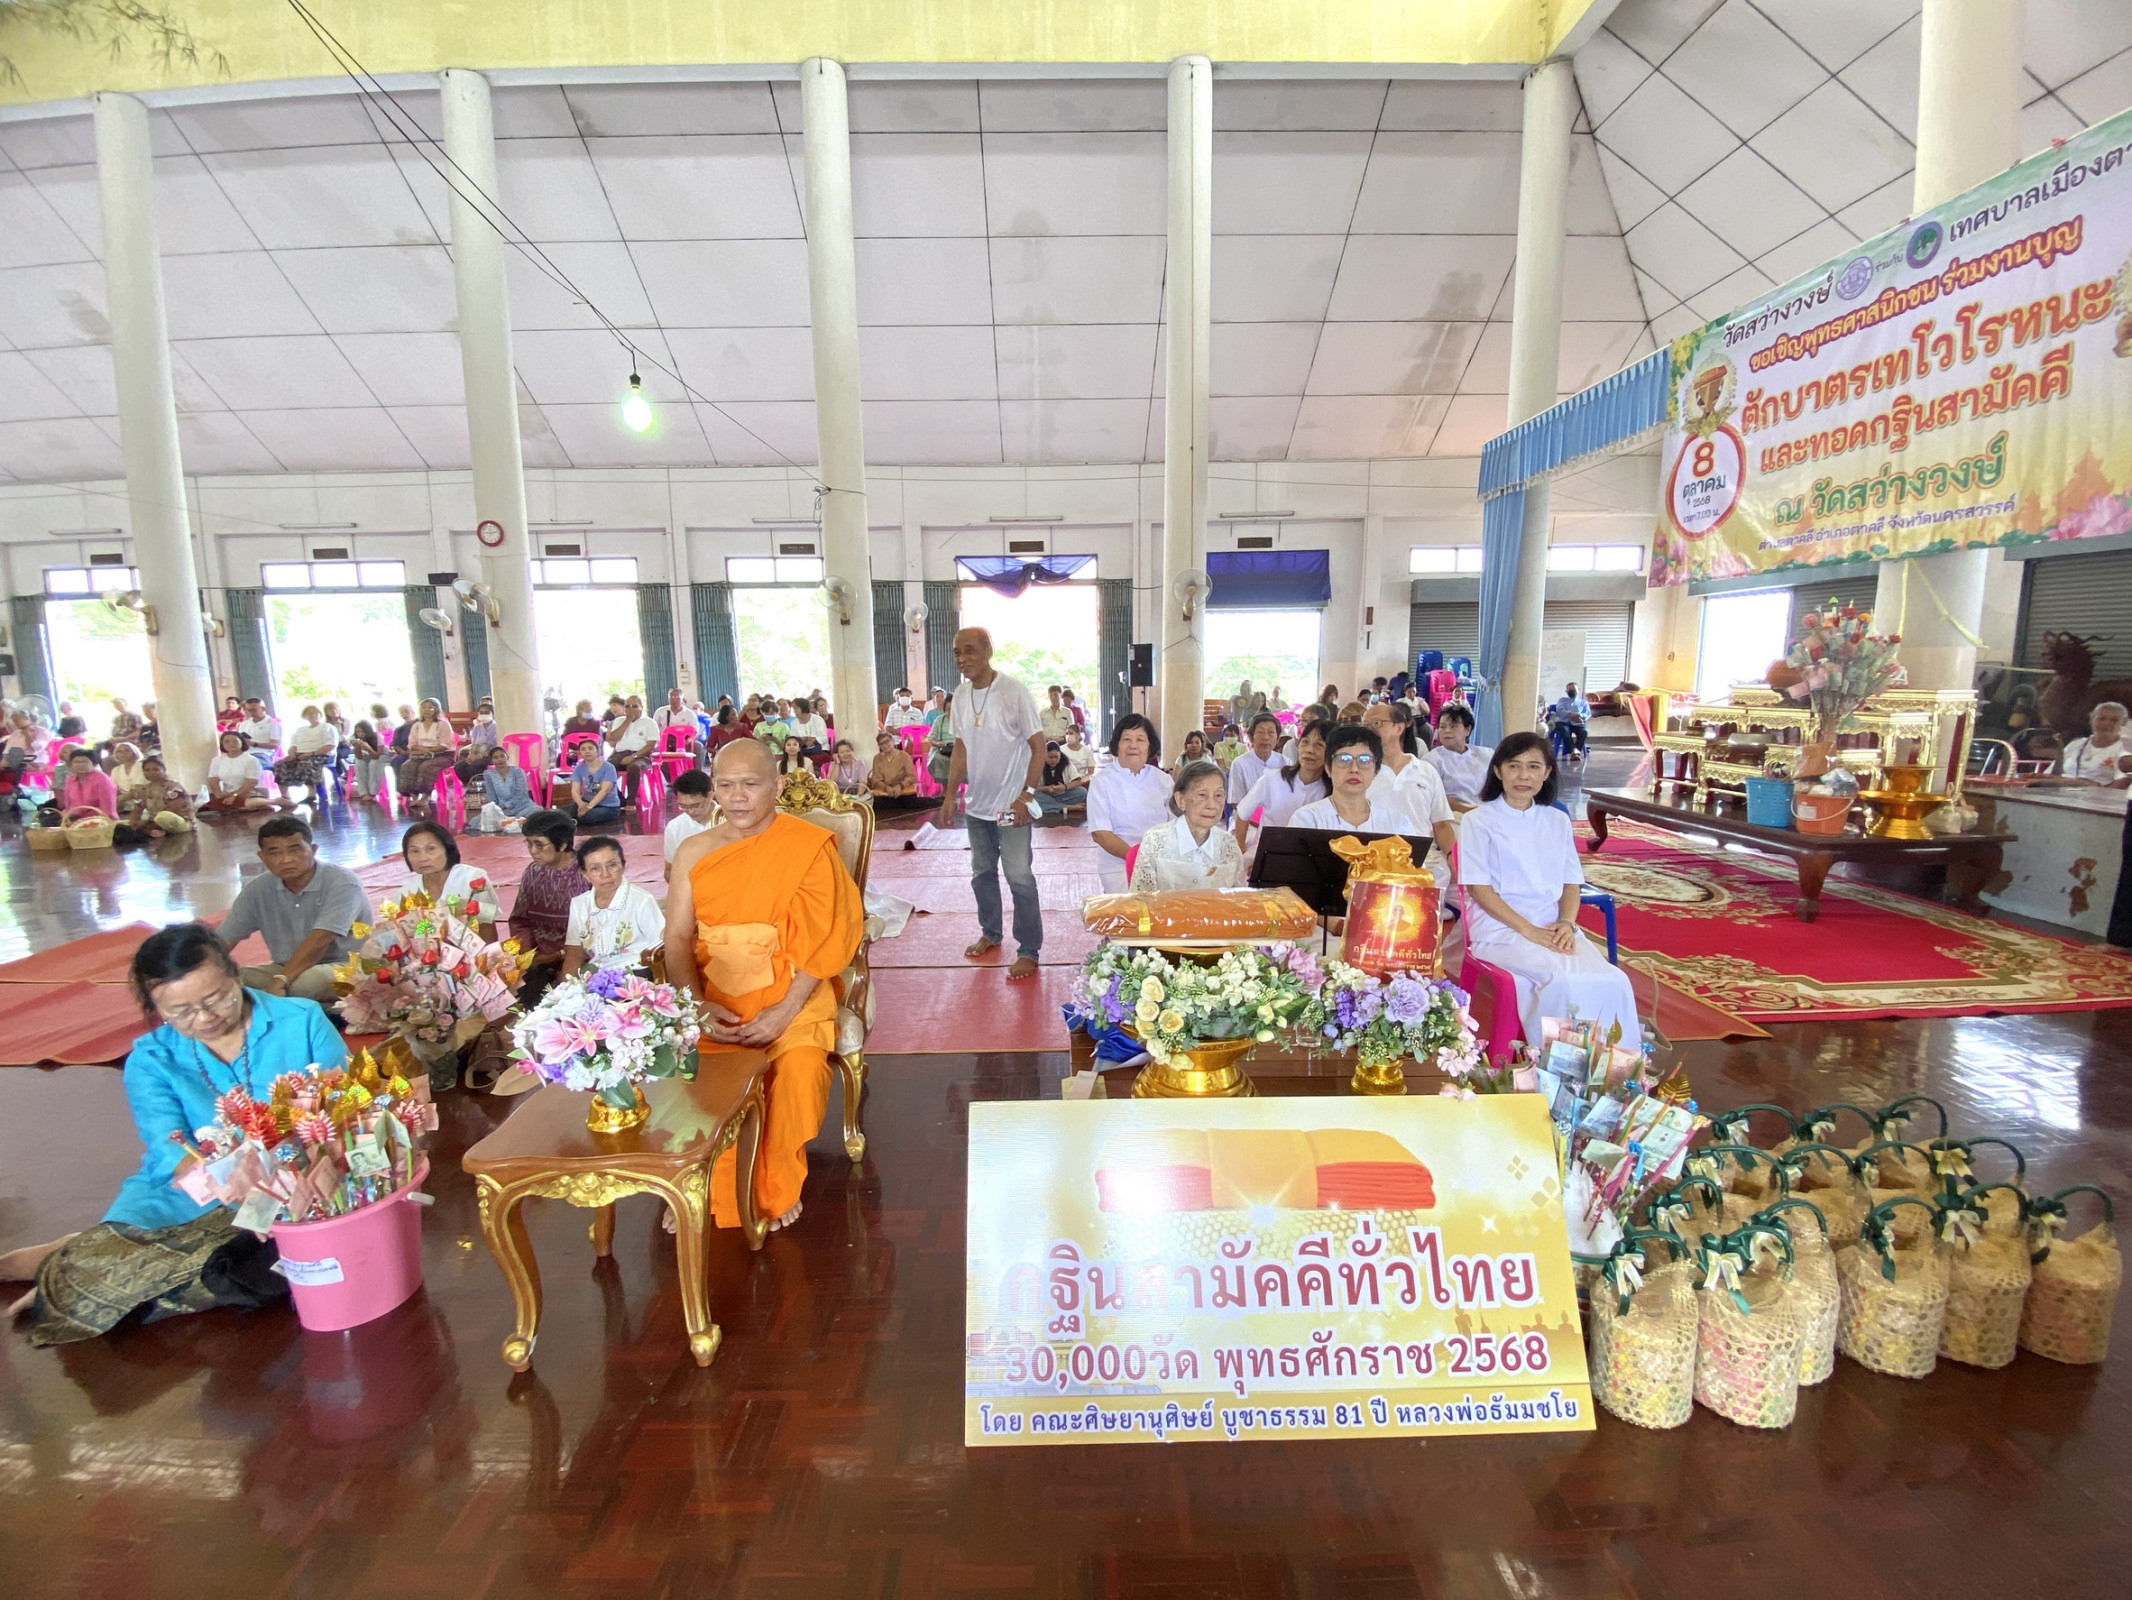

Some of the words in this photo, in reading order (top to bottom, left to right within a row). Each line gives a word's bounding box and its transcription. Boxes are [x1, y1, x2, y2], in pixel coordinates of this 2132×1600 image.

[1723, 269, 1834, 348] วัดสว่างวงษ์
[1750, 276, 1939, 371] ขอเชิญพุทธศาสนิกชน
[1941, 215, 2083, 294] ร่วมงานบุญ
[1741, 277, 2114, 434] ตักบาตรเทโวโรหนะ
[1760, 342, 2073, 473] และทอดกฐินสามัคคี
[1682, 474, 1726, 505] ตุลาคม
[1692, 441, 1715, 478] 8
[1774, 495, 1803, 526] ณ
[1811, 433, 2006, 517] วัดสว่างวงษ์
[1888, 493, 2017, 530] จังหวัดนครสวรรค์
[1007, 1220, 1534, 1334] กฐินสามัคคีทั่วไทย
[1214, 1329, 1432, 1395] พุทธศักราช
[1447, 1335, 1548, 1373] 2568
[981, 1404, 1022, 1432] โดย
[1032, 1400, 1214, 1437] คณะศิษยานุศิษย์
[1222, 1406, 1326, 1436] บูชาธรรม
[1336, 1407, 1363, 1426] 81
[1369, 1399, 1387, 1424] ปี
[1397, 1392, 1577, 1423] หลวงพ่อธัมมชโย
